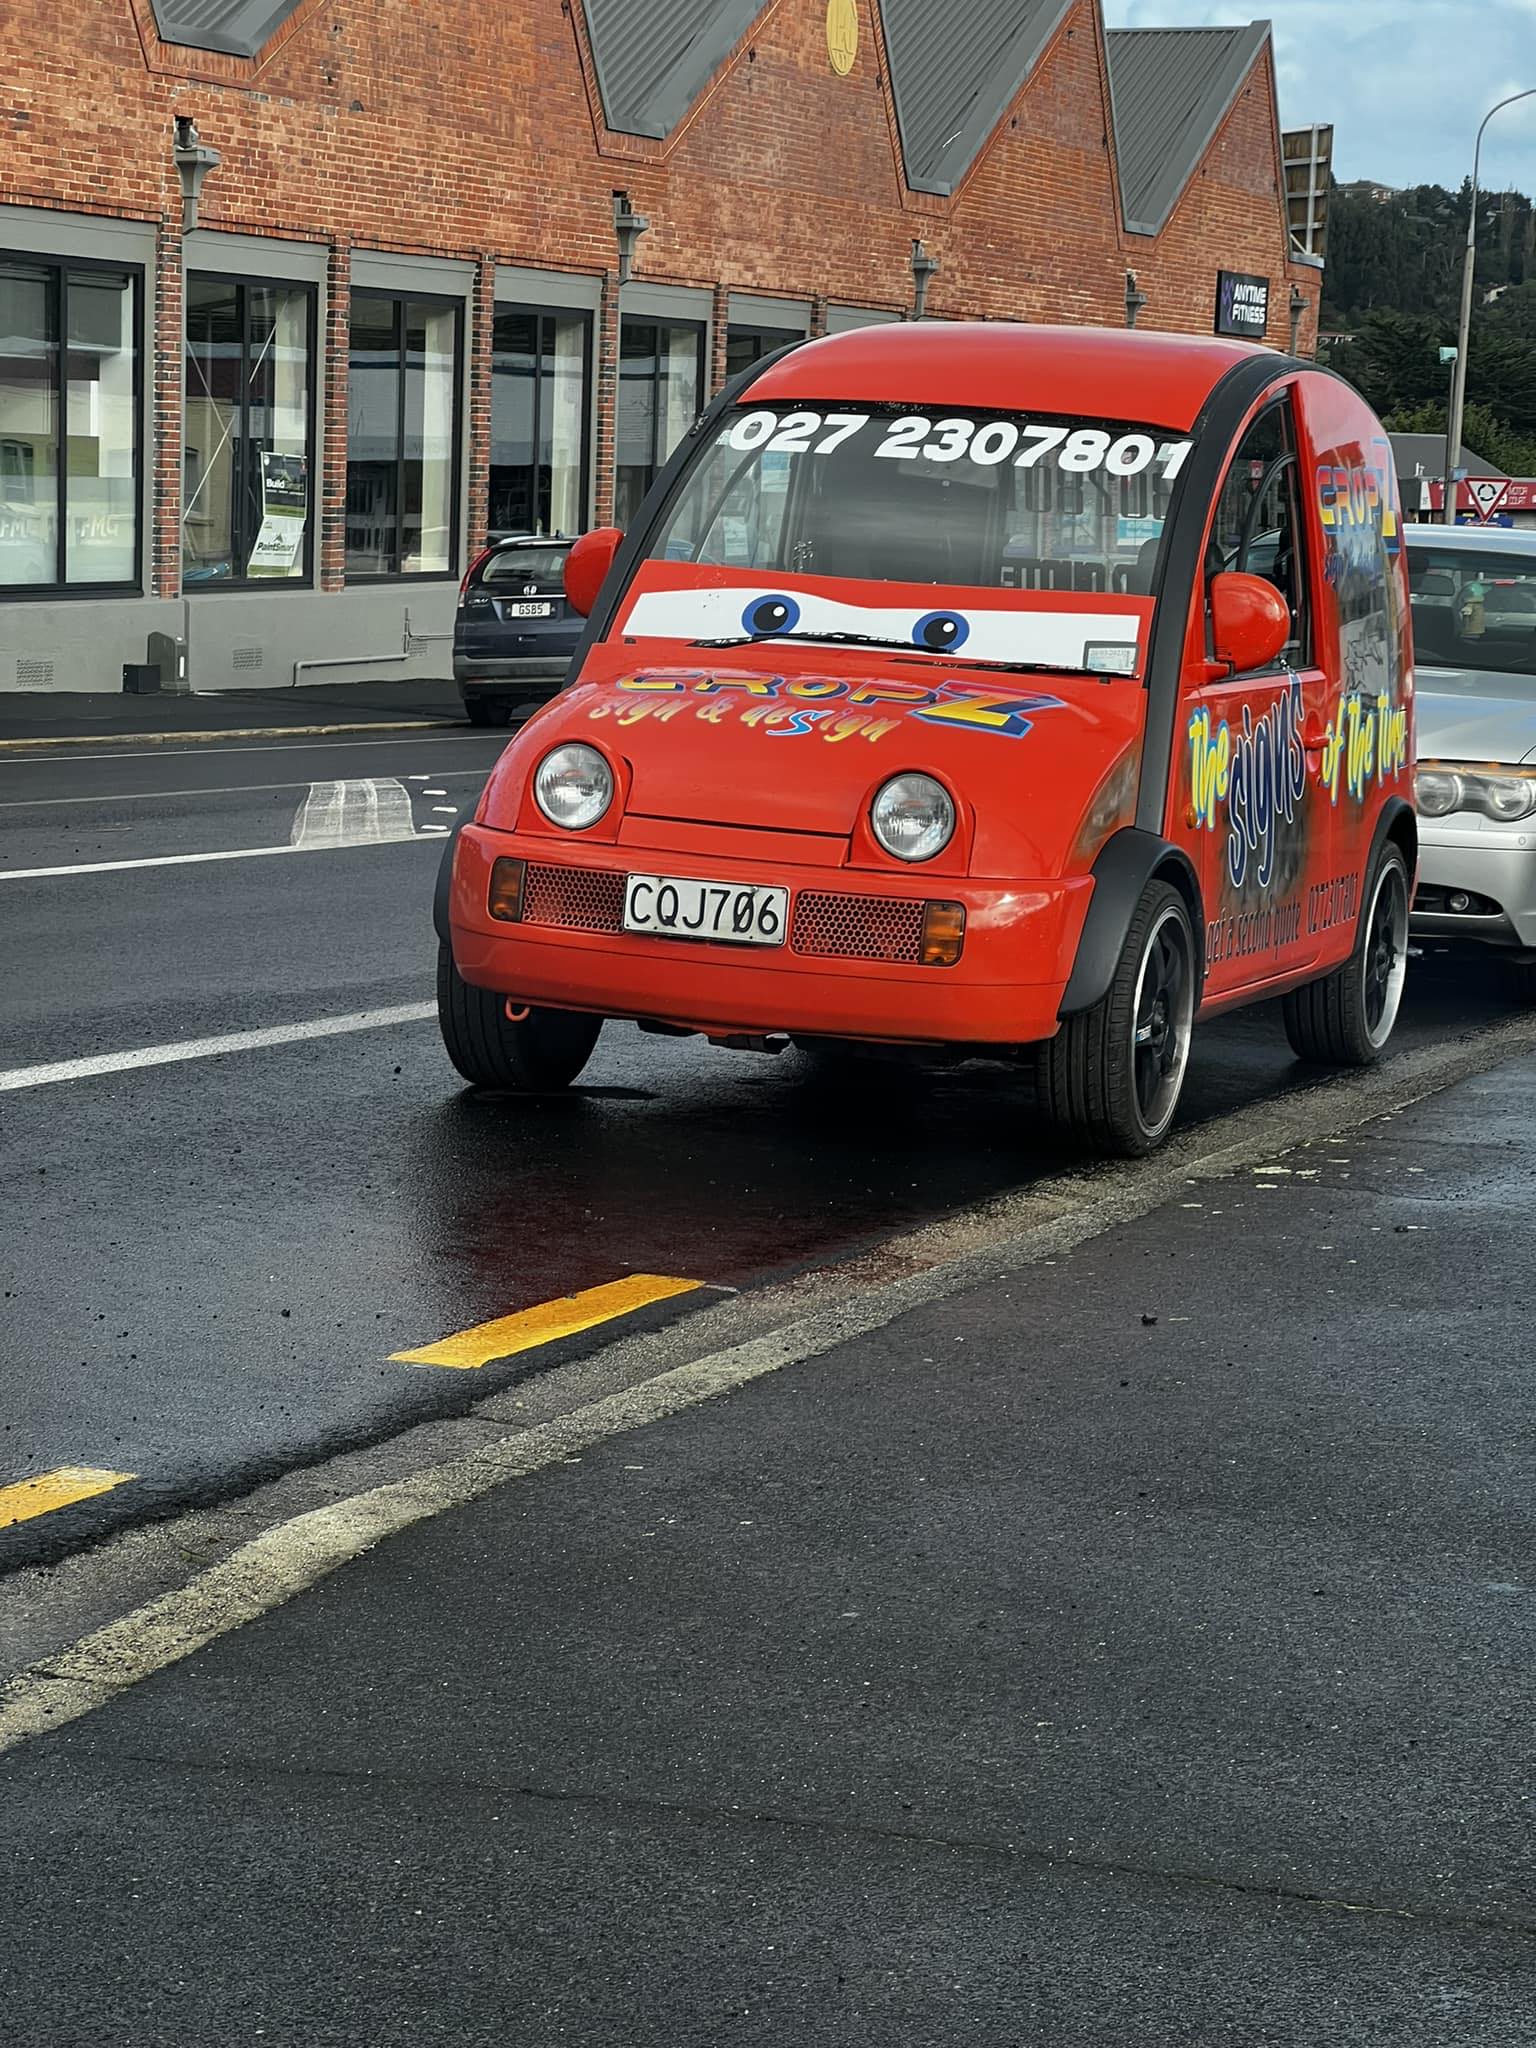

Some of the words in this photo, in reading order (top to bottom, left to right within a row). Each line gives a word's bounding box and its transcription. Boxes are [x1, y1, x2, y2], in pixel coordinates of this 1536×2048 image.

[1233, 283, 1267, 305] ANYTIME
[1231, 303, 1266, 325] FITNESS
[729, 411, 870, 455] 027
[873, 416, 1193, 480] 2307801
[256, 541, 296, 552] PaintSmart
[589, 692, 685, 726] sign
[697, 698, 735, 723] &
[1229, 668, 1305, 888] signs
[630, 882, 779, 935] CQJ706
